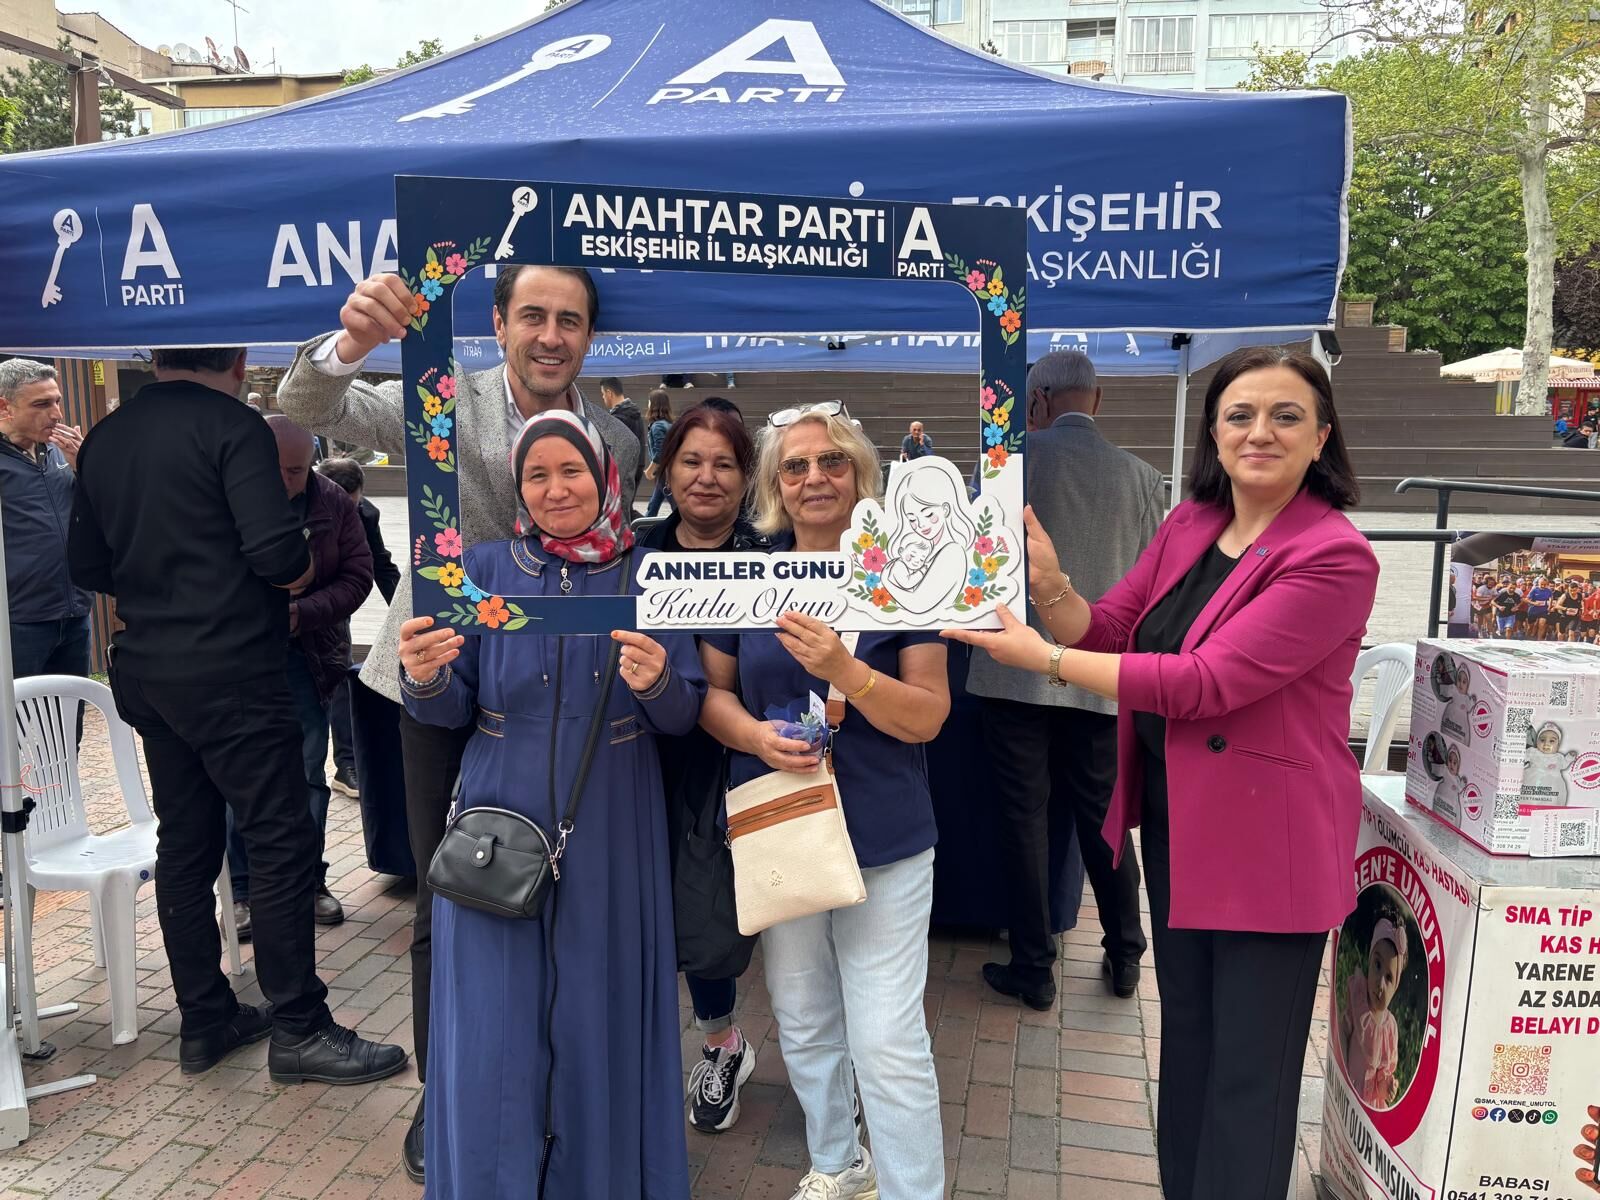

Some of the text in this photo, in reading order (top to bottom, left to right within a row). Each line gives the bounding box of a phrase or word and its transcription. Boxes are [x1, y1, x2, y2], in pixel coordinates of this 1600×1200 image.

[555, 39, 593, 54] A
[665, 18, 847, 86] A
[519, 191, 530, 204] A
[62, 214, 74, 232] A
[563, 193, 763, 237] ANAHTAR
[951, 181, 1222, 243] KİŞEHİR
[121, 203, 182, 280] A
[898, 206, 944, 260] A
[581, 231, 868, 270] ESKİŞEHİR İL BAŞKANLIĞI
[645, 560, 845, 581] ANNELER GÜNÜ
[647, 587, 741, 620] Kutlu
[1505, 905, 1593, 927] SMA TİP
[1540, 935, 1582, 954] KAS
[1401, 864, 1440, 964] UMUT
[1424, 986, 1441, 1048] OL
[1515, 961, 1595, 982] YARENE
[1518, 990, 1547, 1008] AZ
[1510, 1016, 1581, 1035] BELAYI
[1350, 1108, 1373, 1166] OLUR
[1479, 1175, 1550, 1192] BABASI
